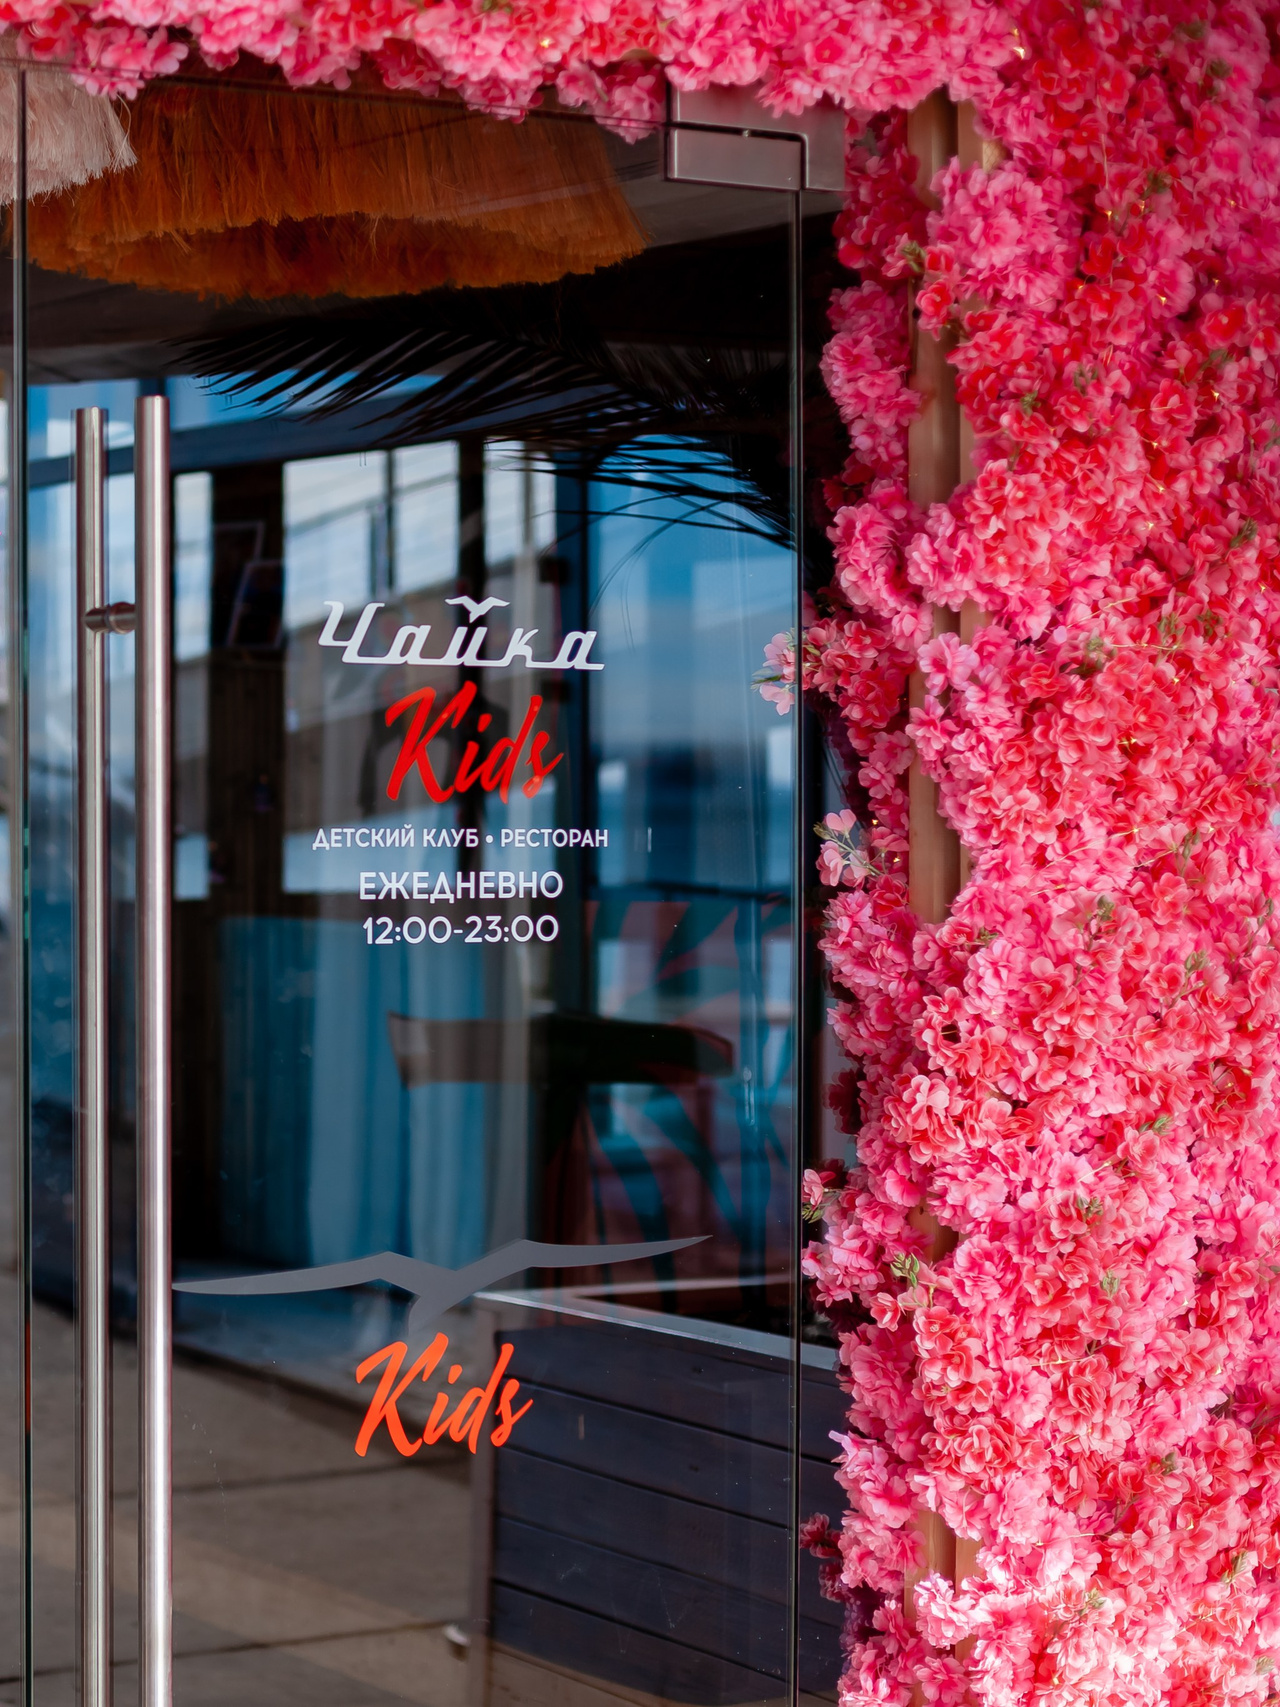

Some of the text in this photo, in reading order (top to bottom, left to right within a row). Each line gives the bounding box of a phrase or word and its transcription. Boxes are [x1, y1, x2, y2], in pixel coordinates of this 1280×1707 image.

[318, 595, 605, 670] Чайка
[385, 680, 564, 804] Kids
[312, 823, 608, 850] ДЕТСКИЙ КЛУБ РЕСТОРАН
[359, 870, 563, 904] ЕЖЕДНЕВНО
[363, 914, 559, 945] 12:00-23:00
[354, 1332, 534, 1458] Kids
